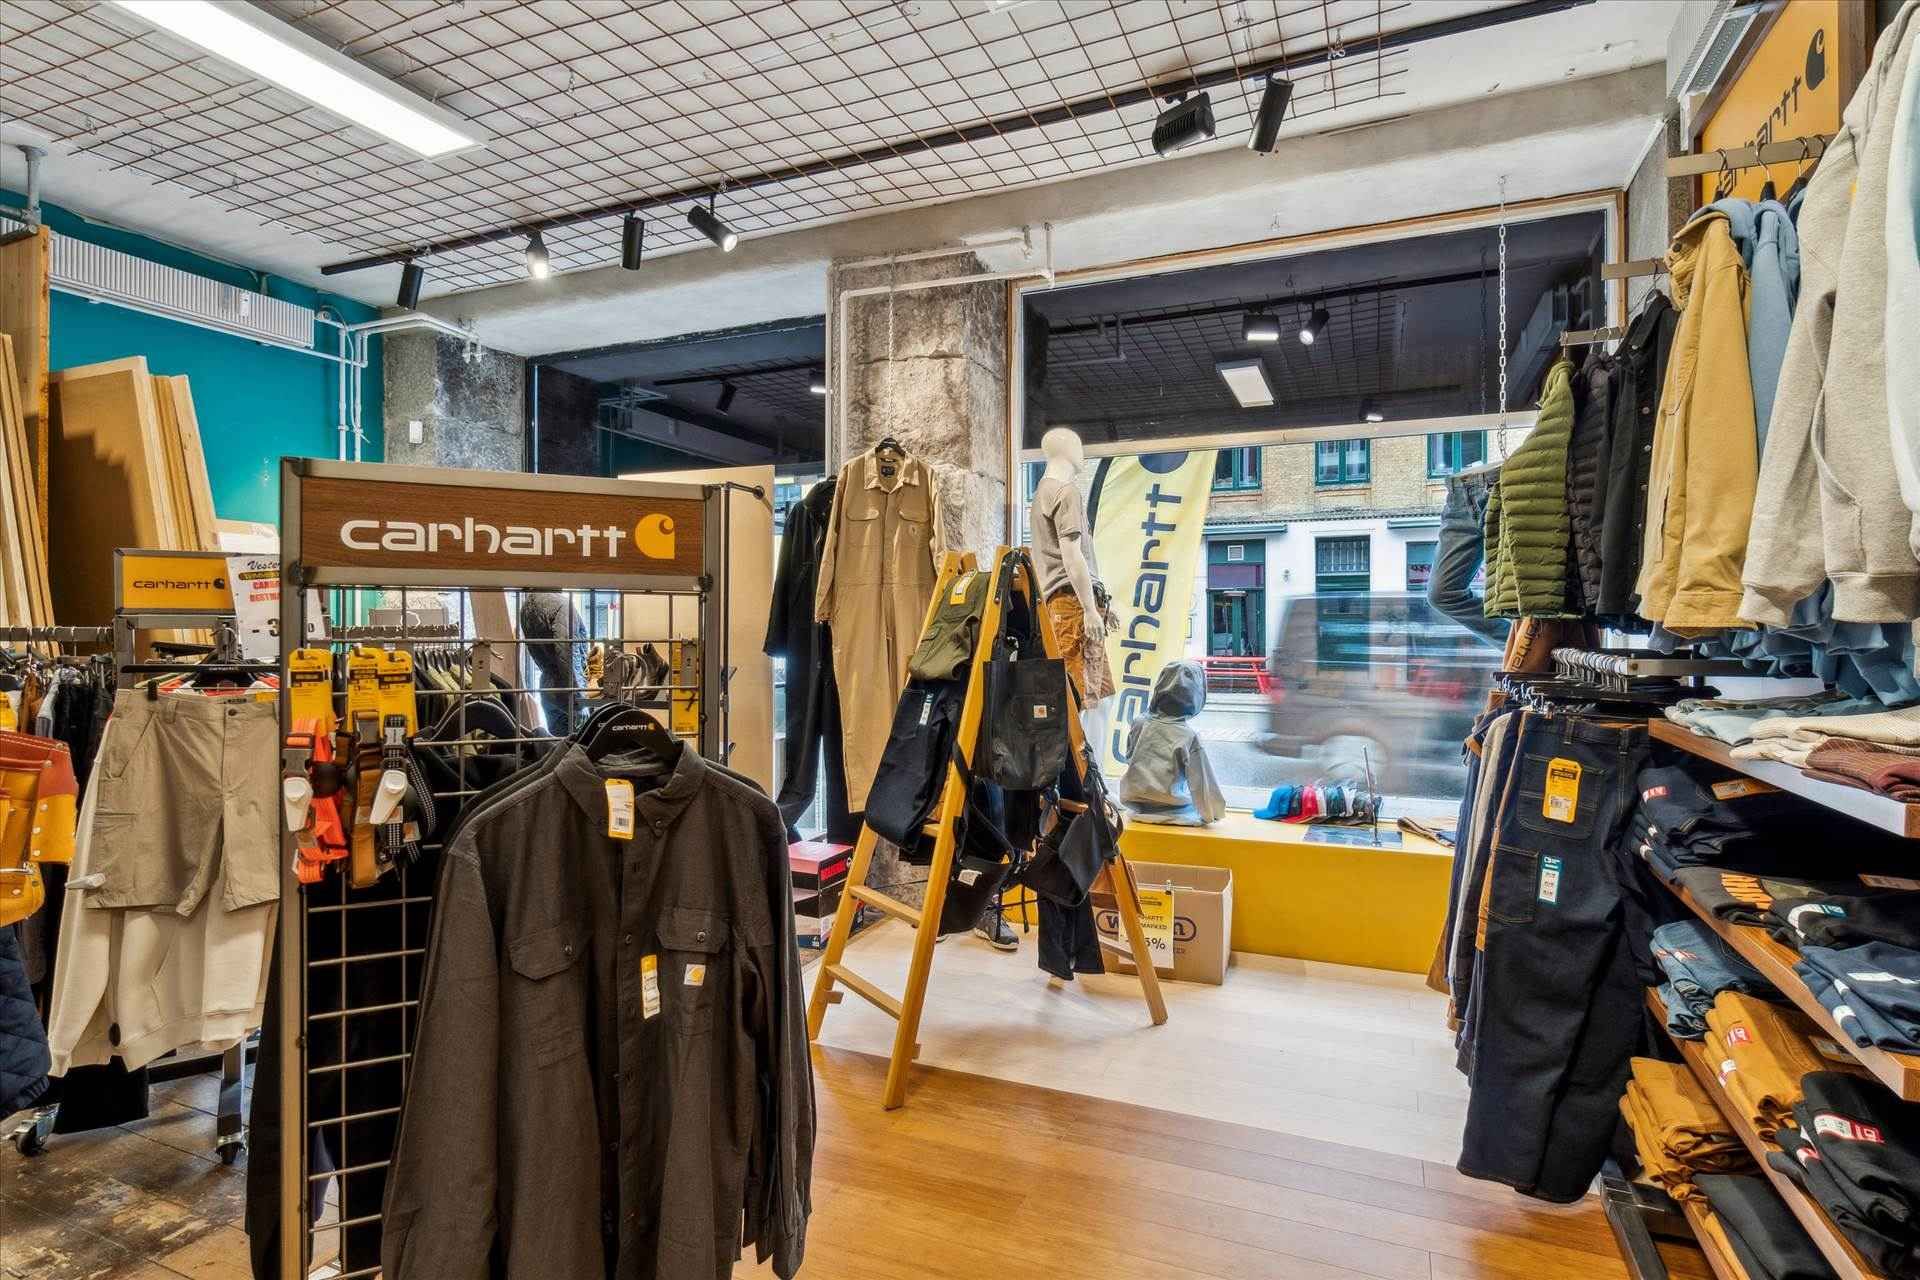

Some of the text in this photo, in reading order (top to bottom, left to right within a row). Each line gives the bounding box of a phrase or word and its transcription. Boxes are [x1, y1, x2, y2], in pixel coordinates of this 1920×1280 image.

[340, 516, 627, 558] carhartt
[133, 580, 211, 590] carhartt
[612, 722, 648, 731] carhartt
[1144, 937, 1166, 950] 5%
